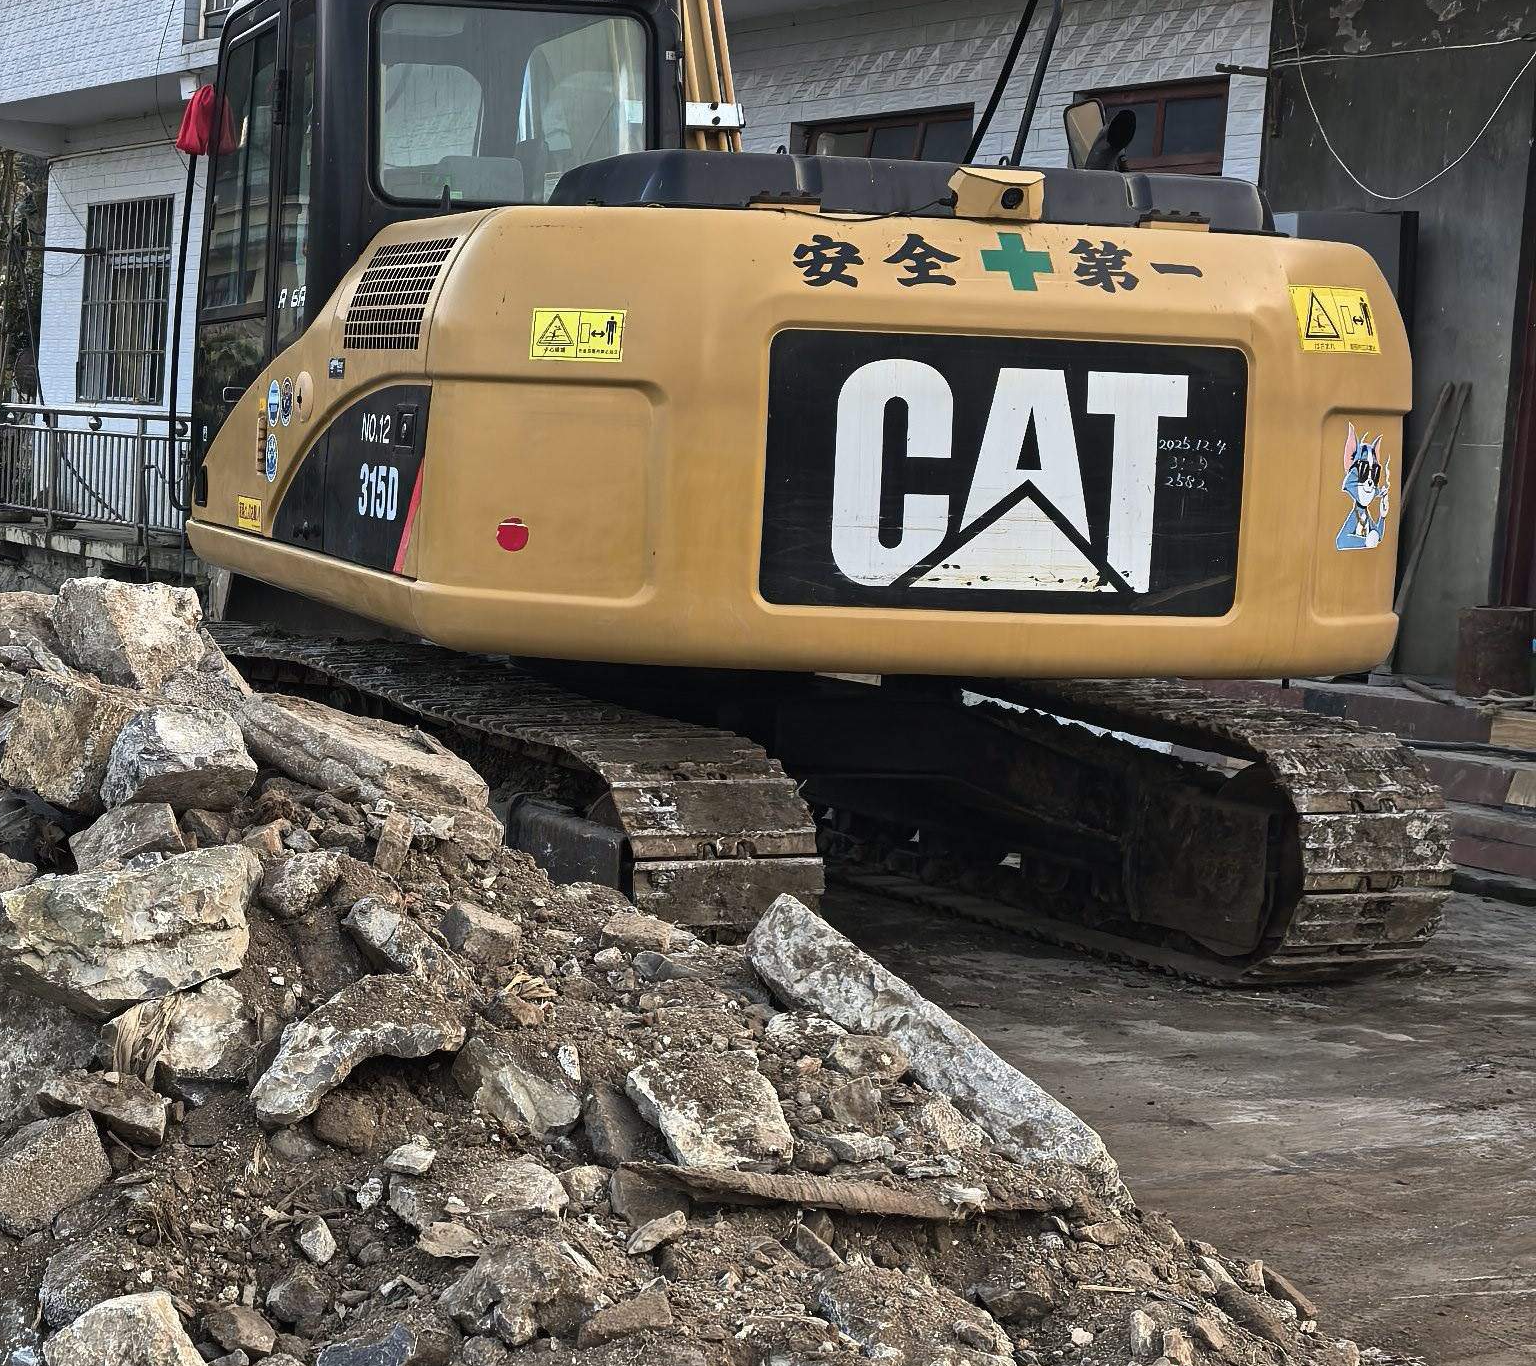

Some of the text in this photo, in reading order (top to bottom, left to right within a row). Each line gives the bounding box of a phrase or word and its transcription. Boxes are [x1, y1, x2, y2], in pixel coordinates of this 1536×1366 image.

[361, 412, 391, 444] NO.12
[358, 462, 399, 521] 315D
[831, 358, 1189, 594] CAT
